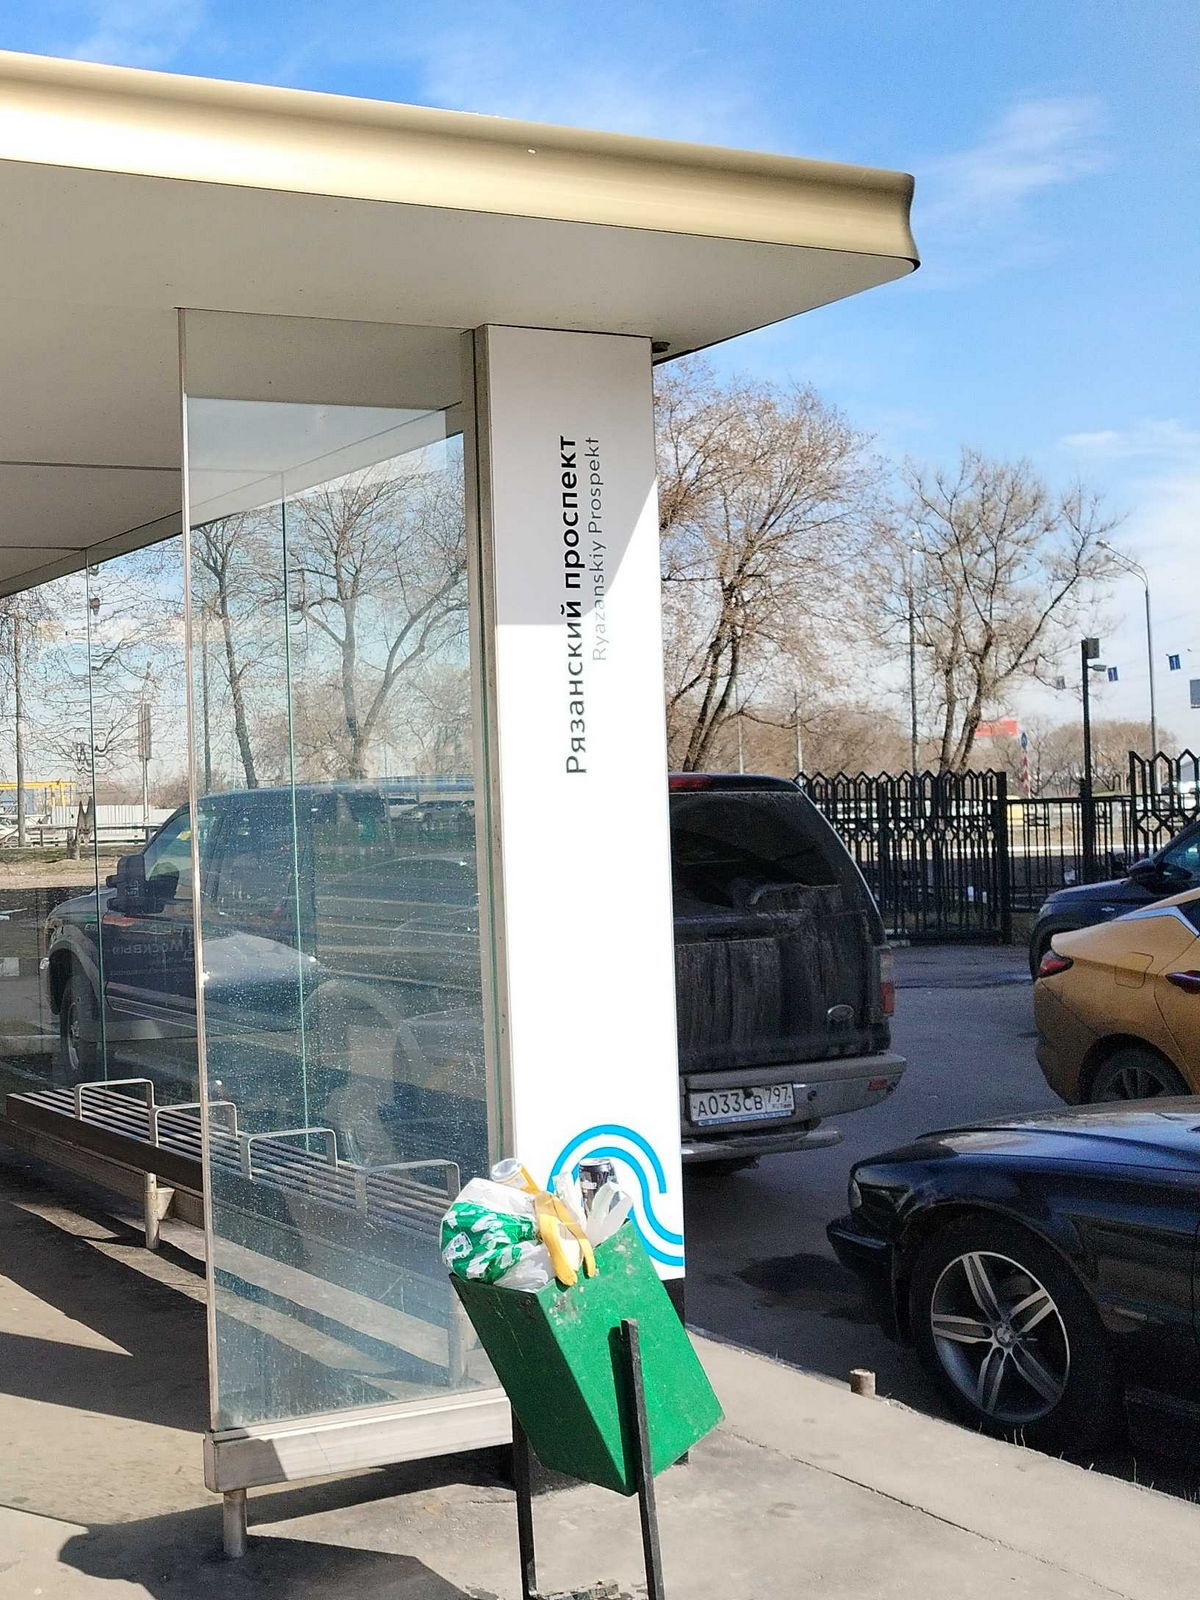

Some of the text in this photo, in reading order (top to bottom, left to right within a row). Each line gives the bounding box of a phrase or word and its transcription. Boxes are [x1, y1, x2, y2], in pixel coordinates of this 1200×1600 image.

[560, 435, 586, 774] Рязанский проспект
[585, 436, 609, 661] Ryazanskiy Prospekt
